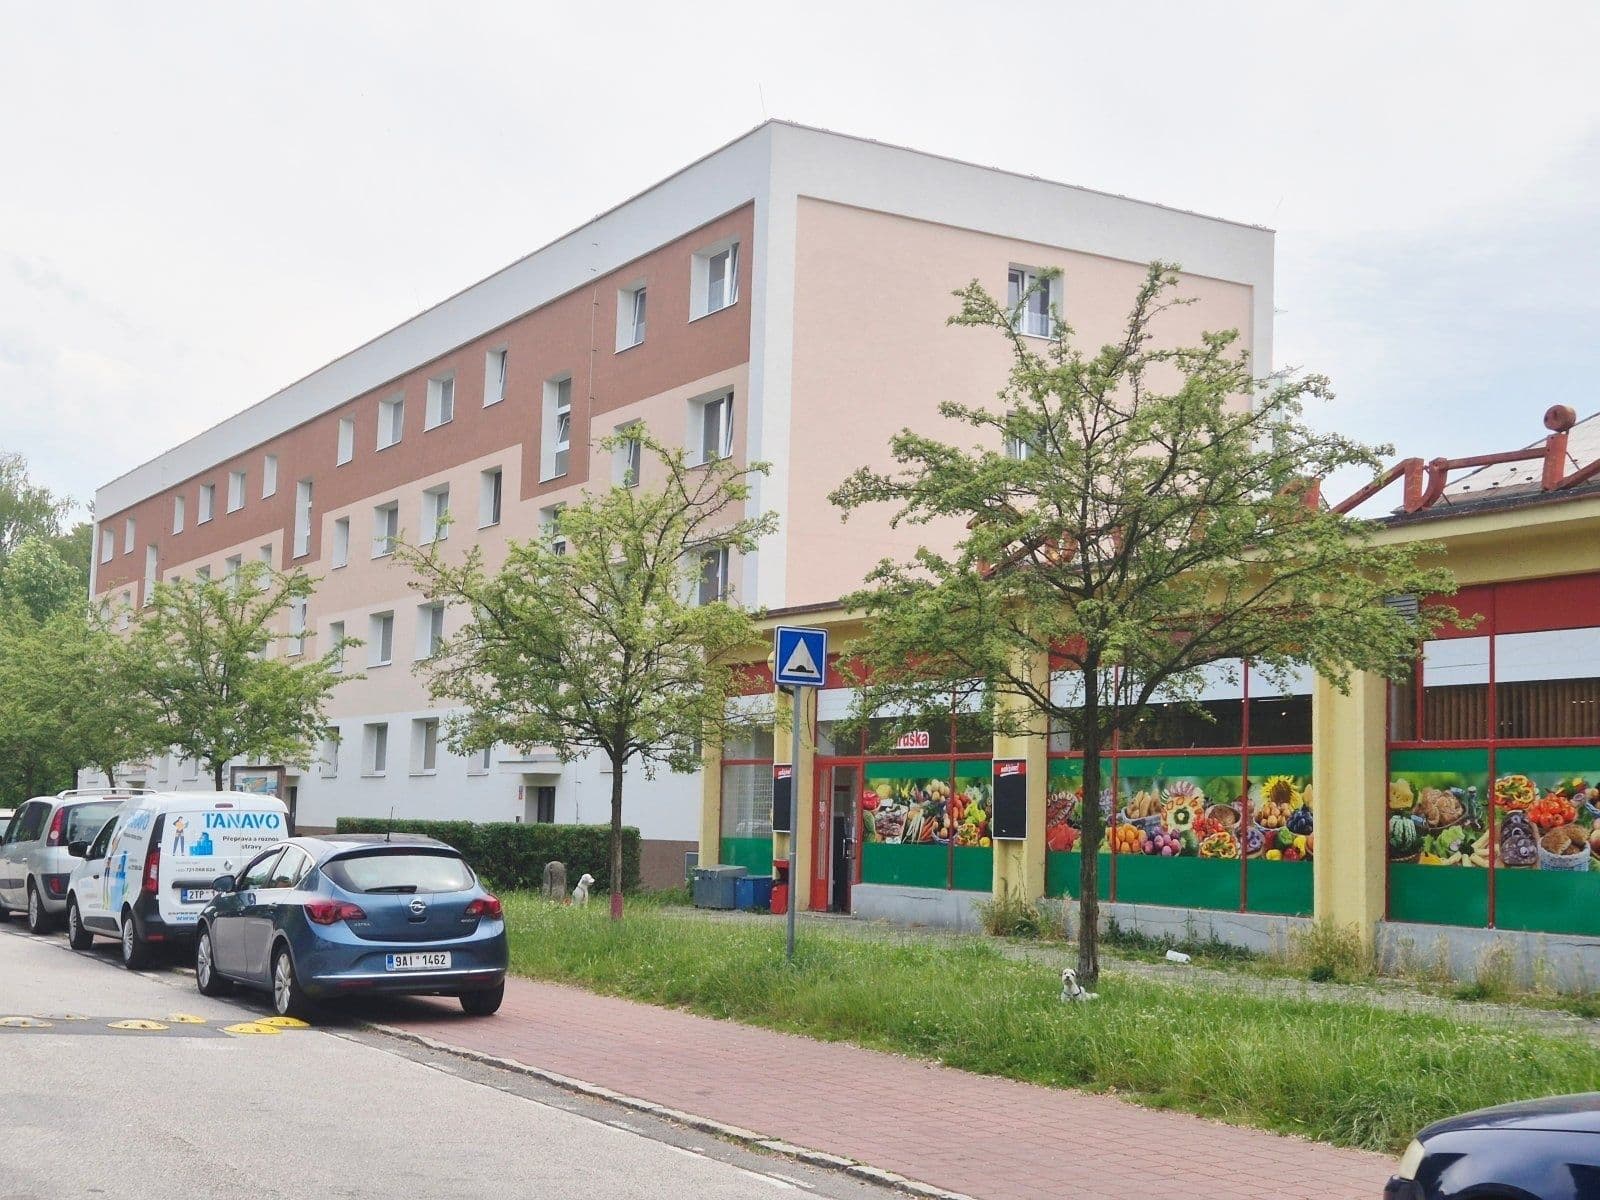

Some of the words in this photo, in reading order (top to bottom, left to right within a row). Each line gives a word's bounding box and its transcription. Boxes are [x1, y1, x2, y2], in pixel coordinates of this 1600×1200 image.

[202, 813, 280, 829] TANAVO
[189, 890, 205, 899] 2TP
[395, 956, 413, 967] 9AI
[422, 954, 446, 965] 1462
